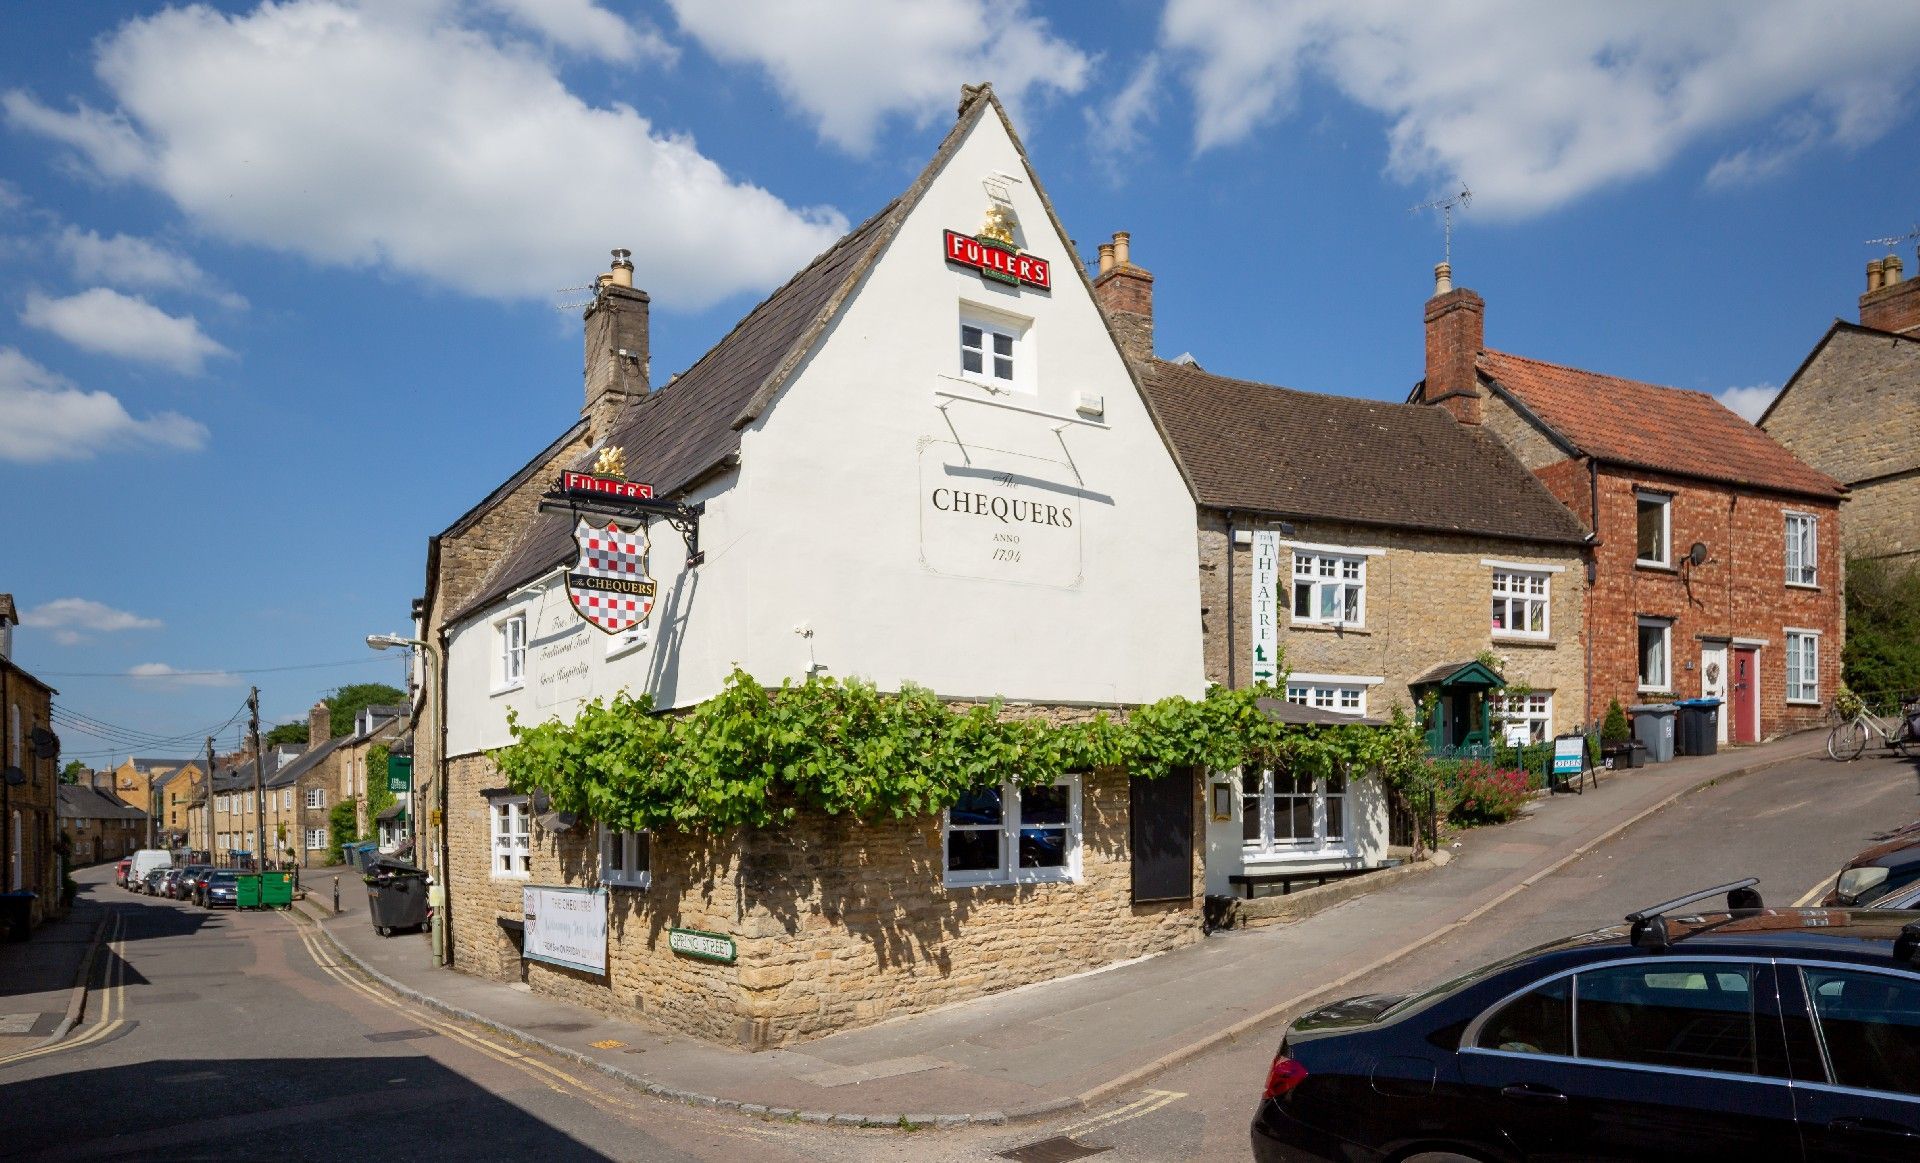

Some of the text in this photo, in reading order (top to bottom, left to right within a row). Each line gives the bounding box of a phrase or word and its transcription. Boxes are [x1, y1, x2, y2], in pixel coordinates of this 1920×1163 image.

[953, 236, 1045, 281] FULLER'S
[570, 474, 649, 498] FULLER'S
[992, 472, 1020, 489] The
[932, 488, 1073, 528] CHEQUERS
[992, 533, 1021, 545] ANNO
[992, 547, 1022, 563] 1794
[585, 577, 653, 595] CHEQUERS
[1258, 543, 1273, 640] THEATRE
[562, 898, 592, 913] CHEQUERS
[673, 934, 729, 956] SPRING STREET
